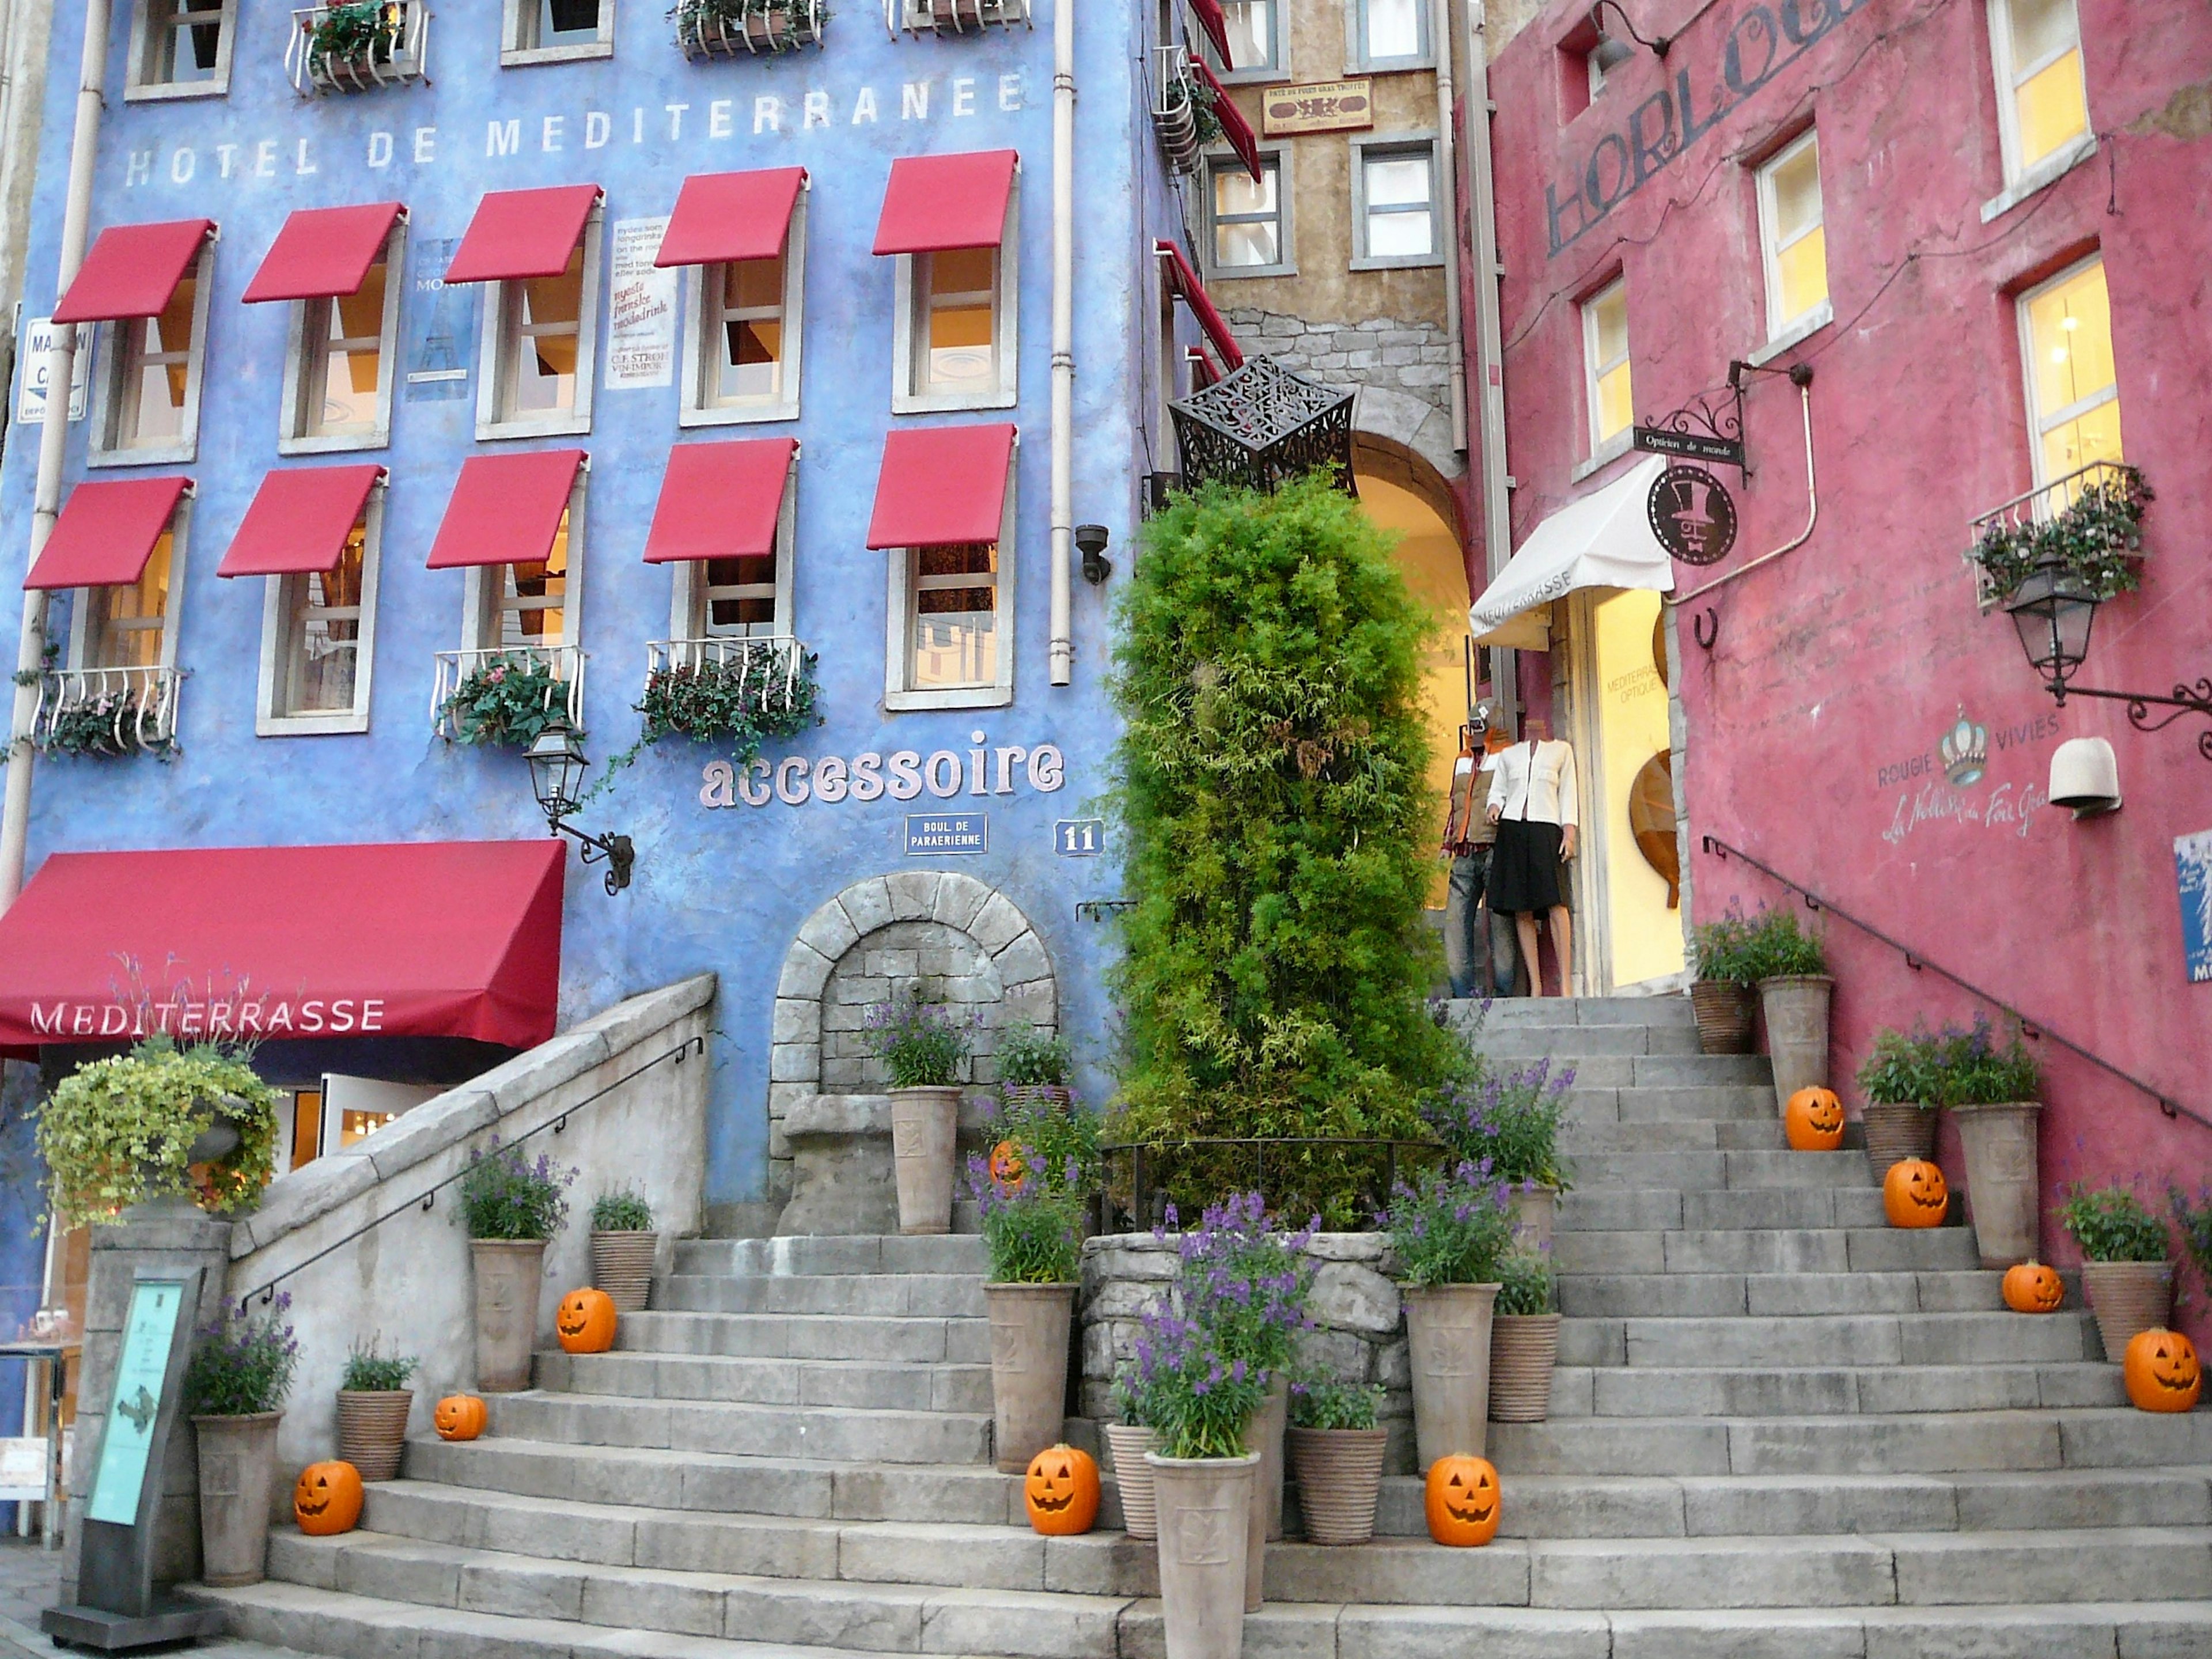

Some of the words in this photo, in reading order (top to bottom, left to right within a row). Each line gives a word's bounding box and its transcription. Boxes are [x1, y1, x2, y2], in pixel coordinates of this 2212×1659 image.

[126, 139, 316, 187] HOTEL
[368, 127, 436, 167] DE
[486, 73, 1021, 157] MEDITERRANEE
[1687, 441, 1697, 452] de
[1702, 445, 1731, 456] monde
[1620, 676, 1657, 704] OPTIQUE
[698, 730, 1065, 808] accessoire
[1985, 782, 2015, 828] Foie
[2016, 782, 2050, 837] Gra
[911, 834, 981, 847] PARAERIENNE
[956, 821, 969, 832] DE
[1065, 825, 1094, 851] 11
[30, 999, 385, 1036] MEDITERRASSE
